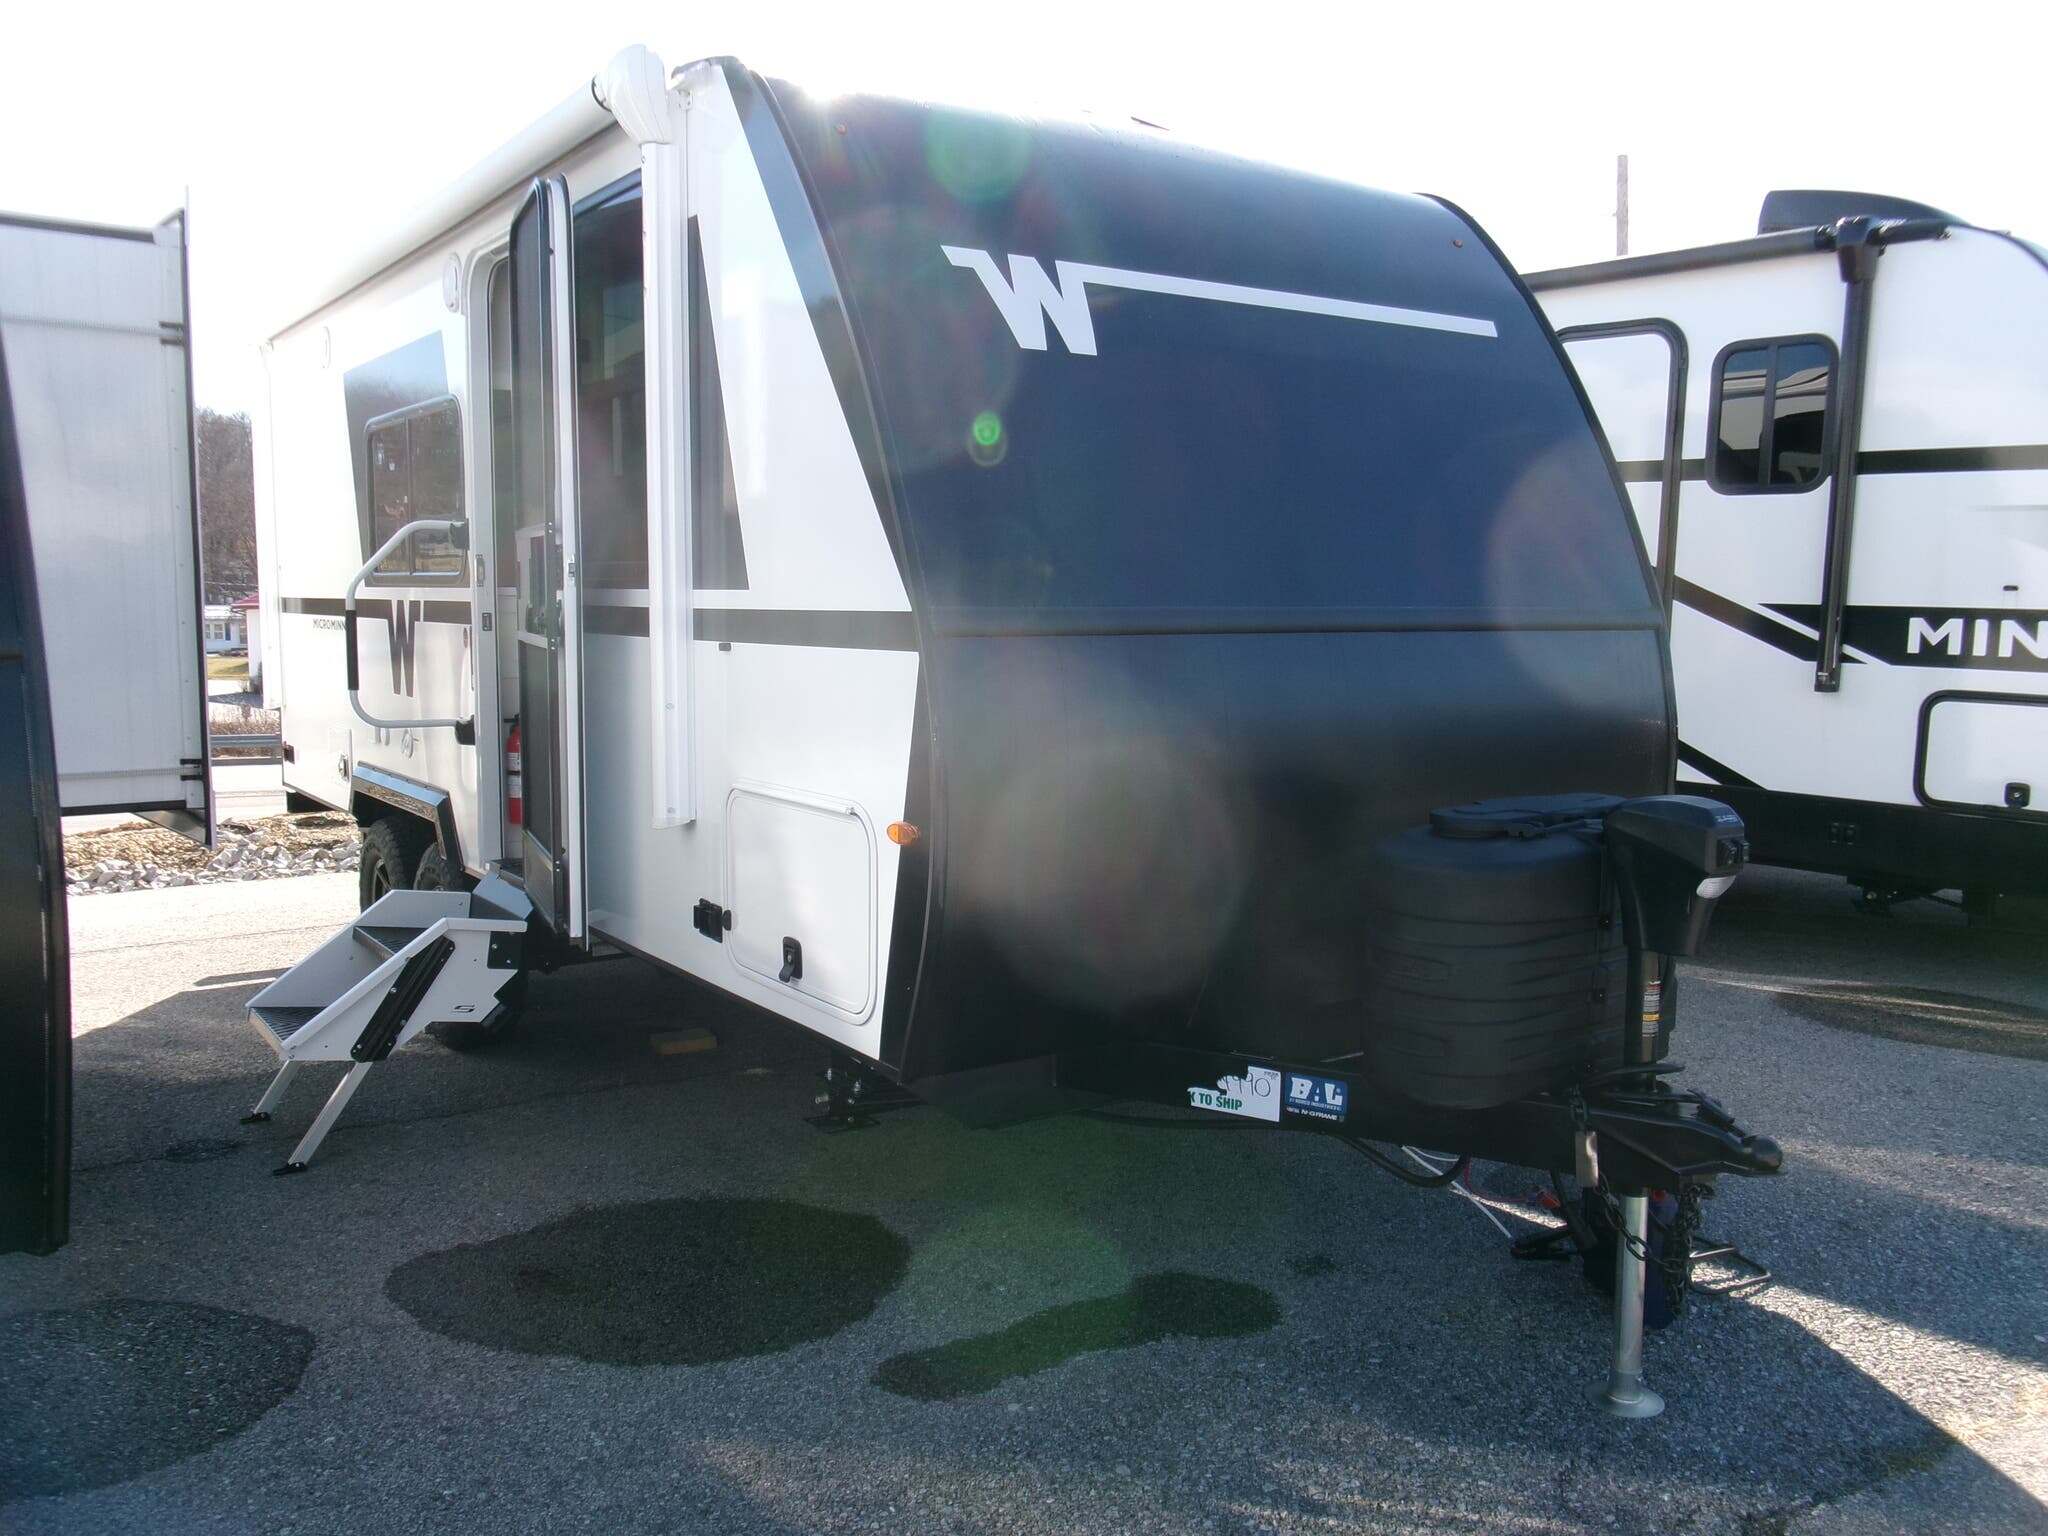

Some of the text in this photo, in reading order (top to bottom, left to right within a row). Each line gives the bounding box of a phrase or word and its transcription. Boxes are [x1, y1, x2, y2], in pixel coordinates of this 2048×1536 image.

[1906, 617, 2048, 660] MIN
[1198, 1092, 1213, 1106] TO
[1215, 1096, 1243, 1111] SHIP
